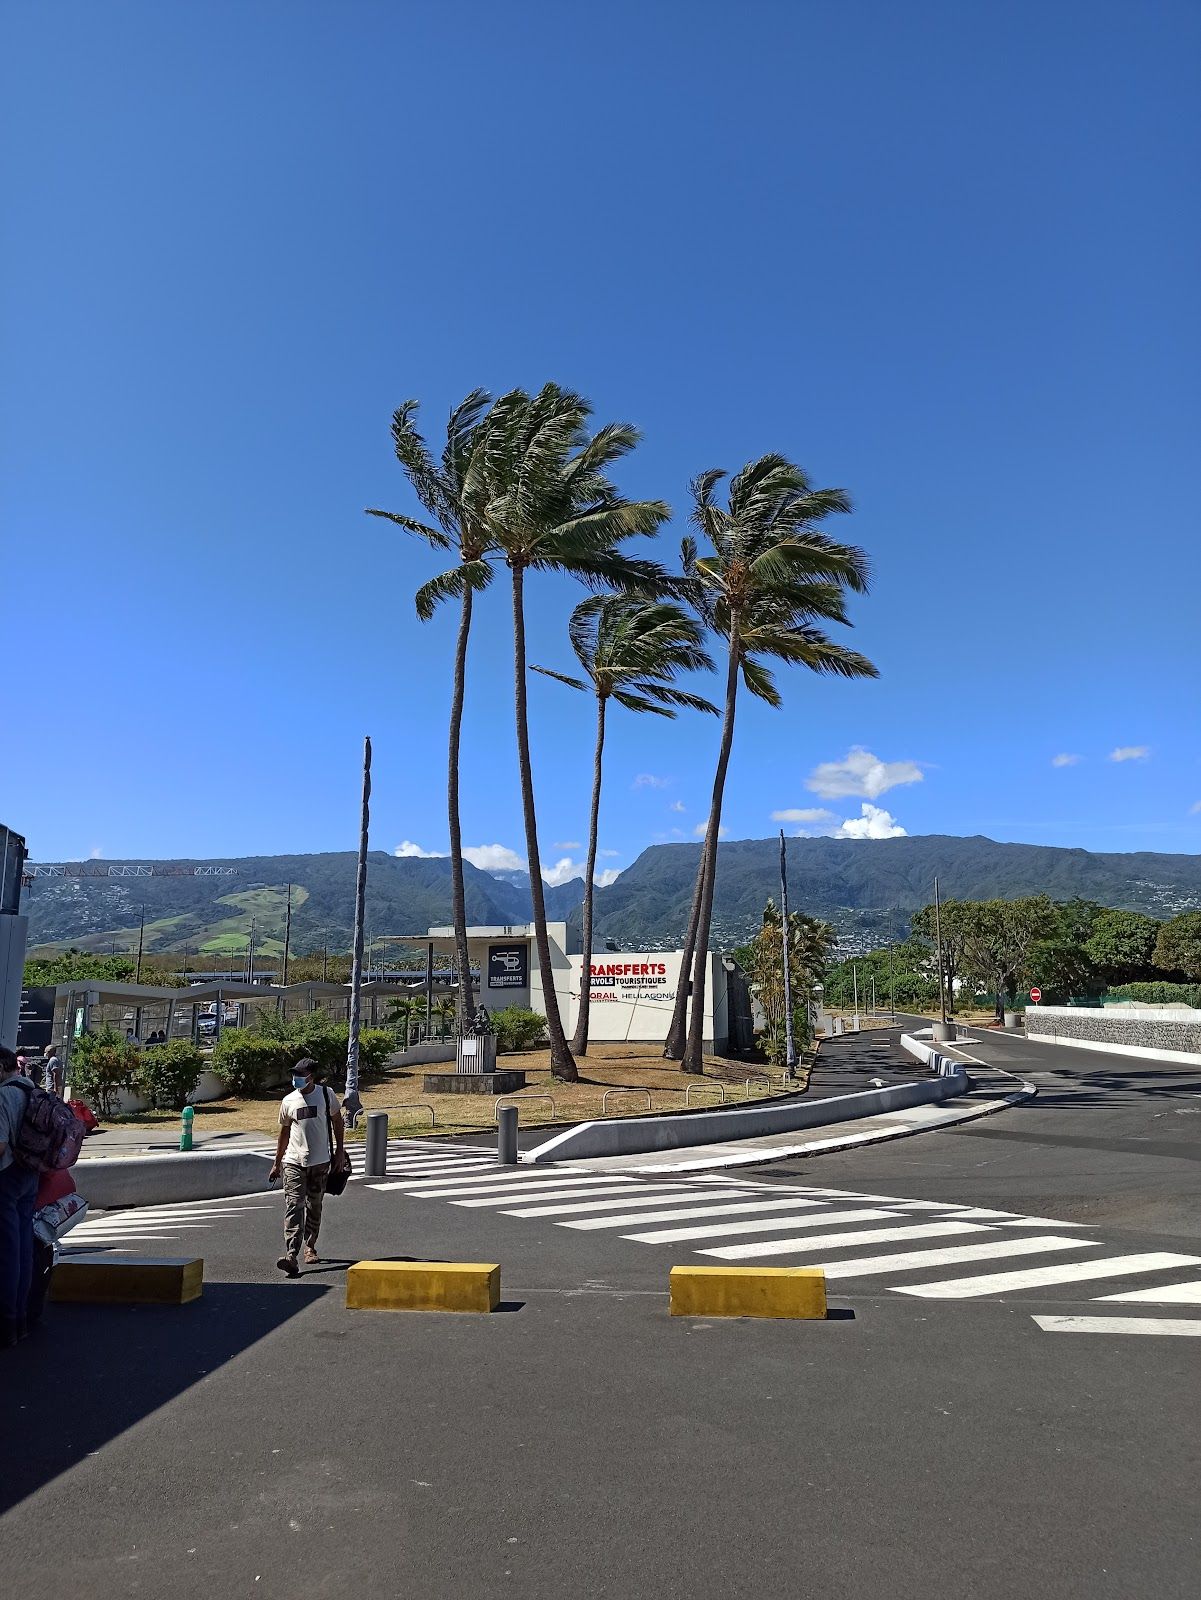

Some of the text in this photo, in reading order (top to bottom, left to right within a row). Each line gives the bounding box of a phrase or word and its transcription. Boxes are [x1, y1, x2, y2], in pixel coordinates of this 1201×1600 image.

[580, 964, 666, 976] RANSFERTS
[590, 977, 667, 986] RVOLS TOURISTIQUES
